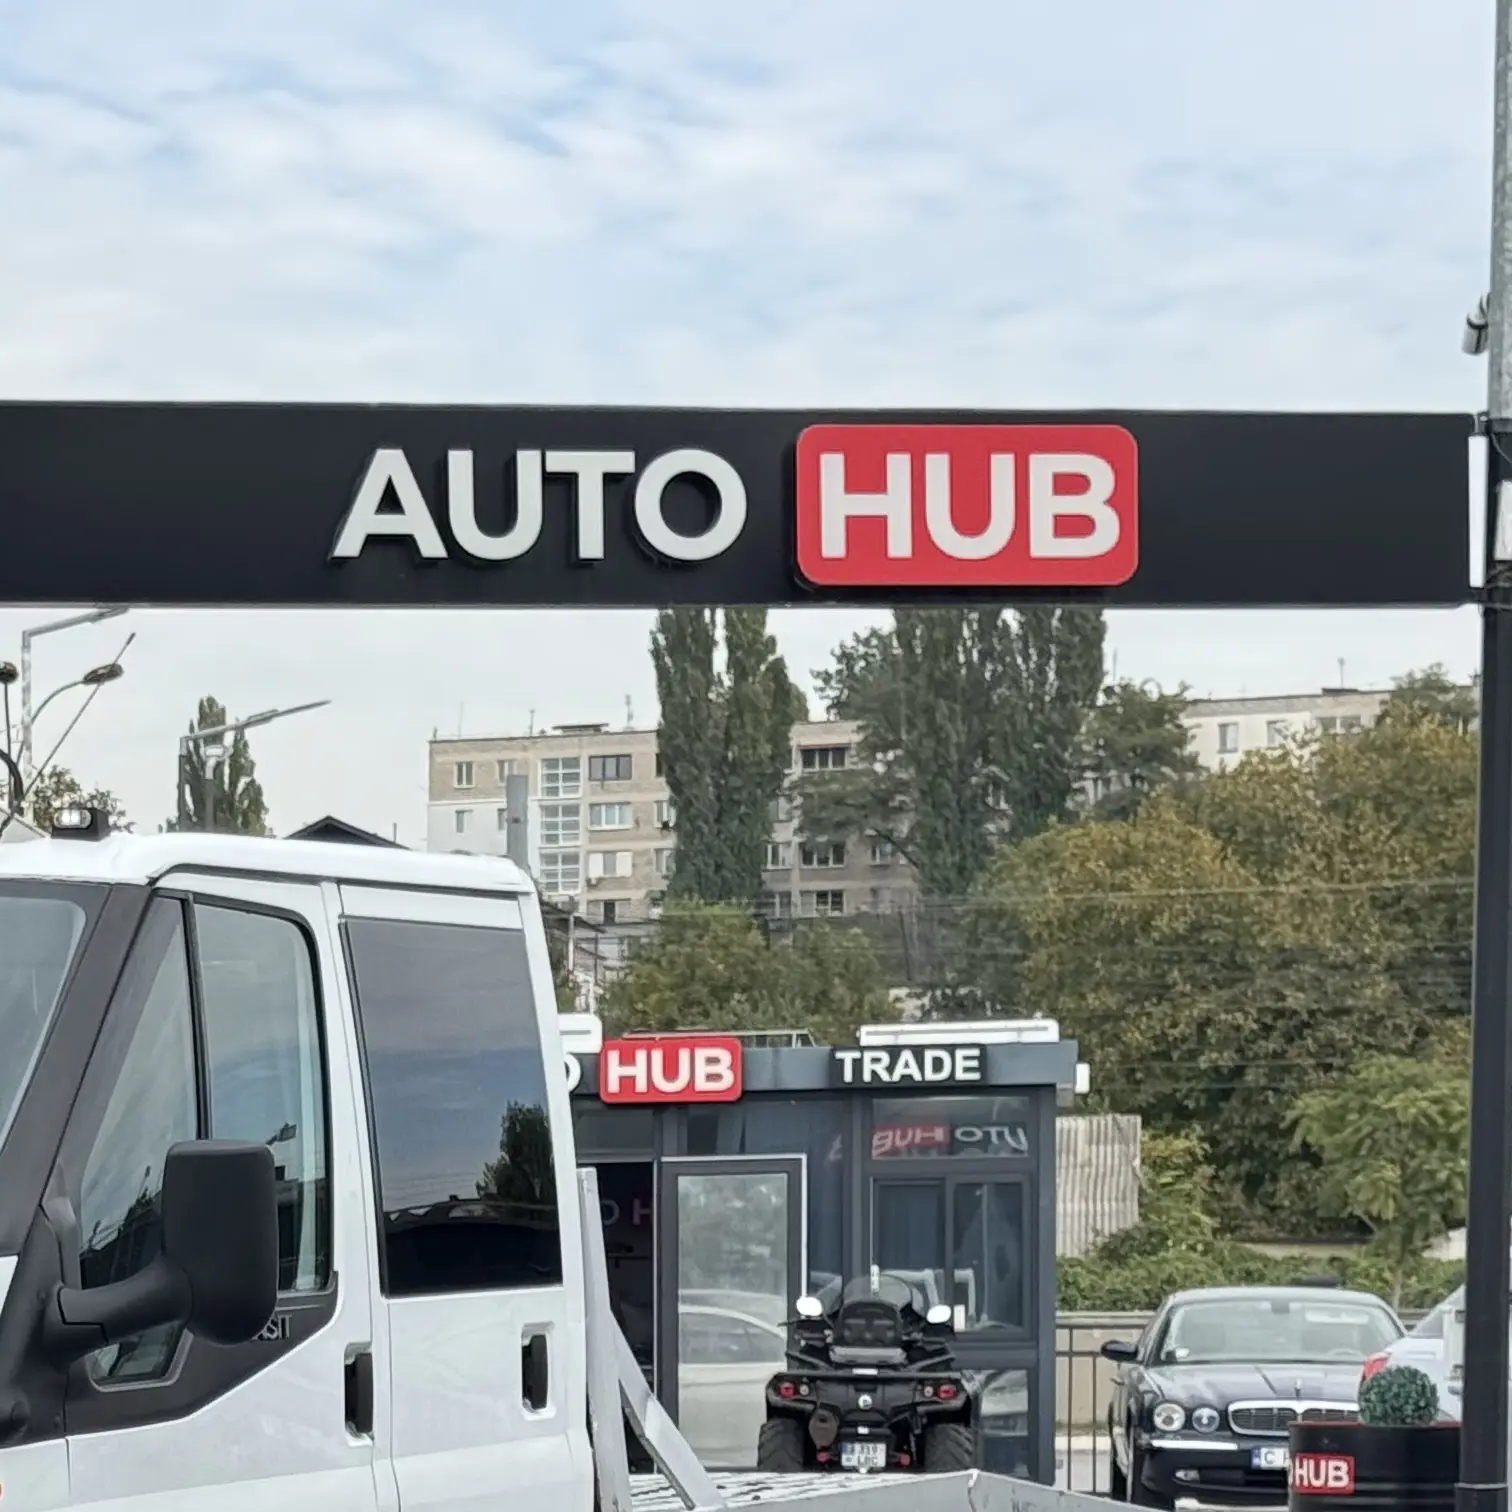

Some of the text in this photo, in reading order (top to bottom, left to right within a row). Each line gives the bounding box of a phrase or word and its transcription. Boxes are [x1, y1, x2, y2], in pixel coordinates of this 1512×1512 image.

[330, 448, 1122, 562] AUTO HUB
[607, 1047, 735, 1093] HUB
[835, 1048, 981, 1083] TRADE
[1295, 1457, 1349, 1488] HUB
